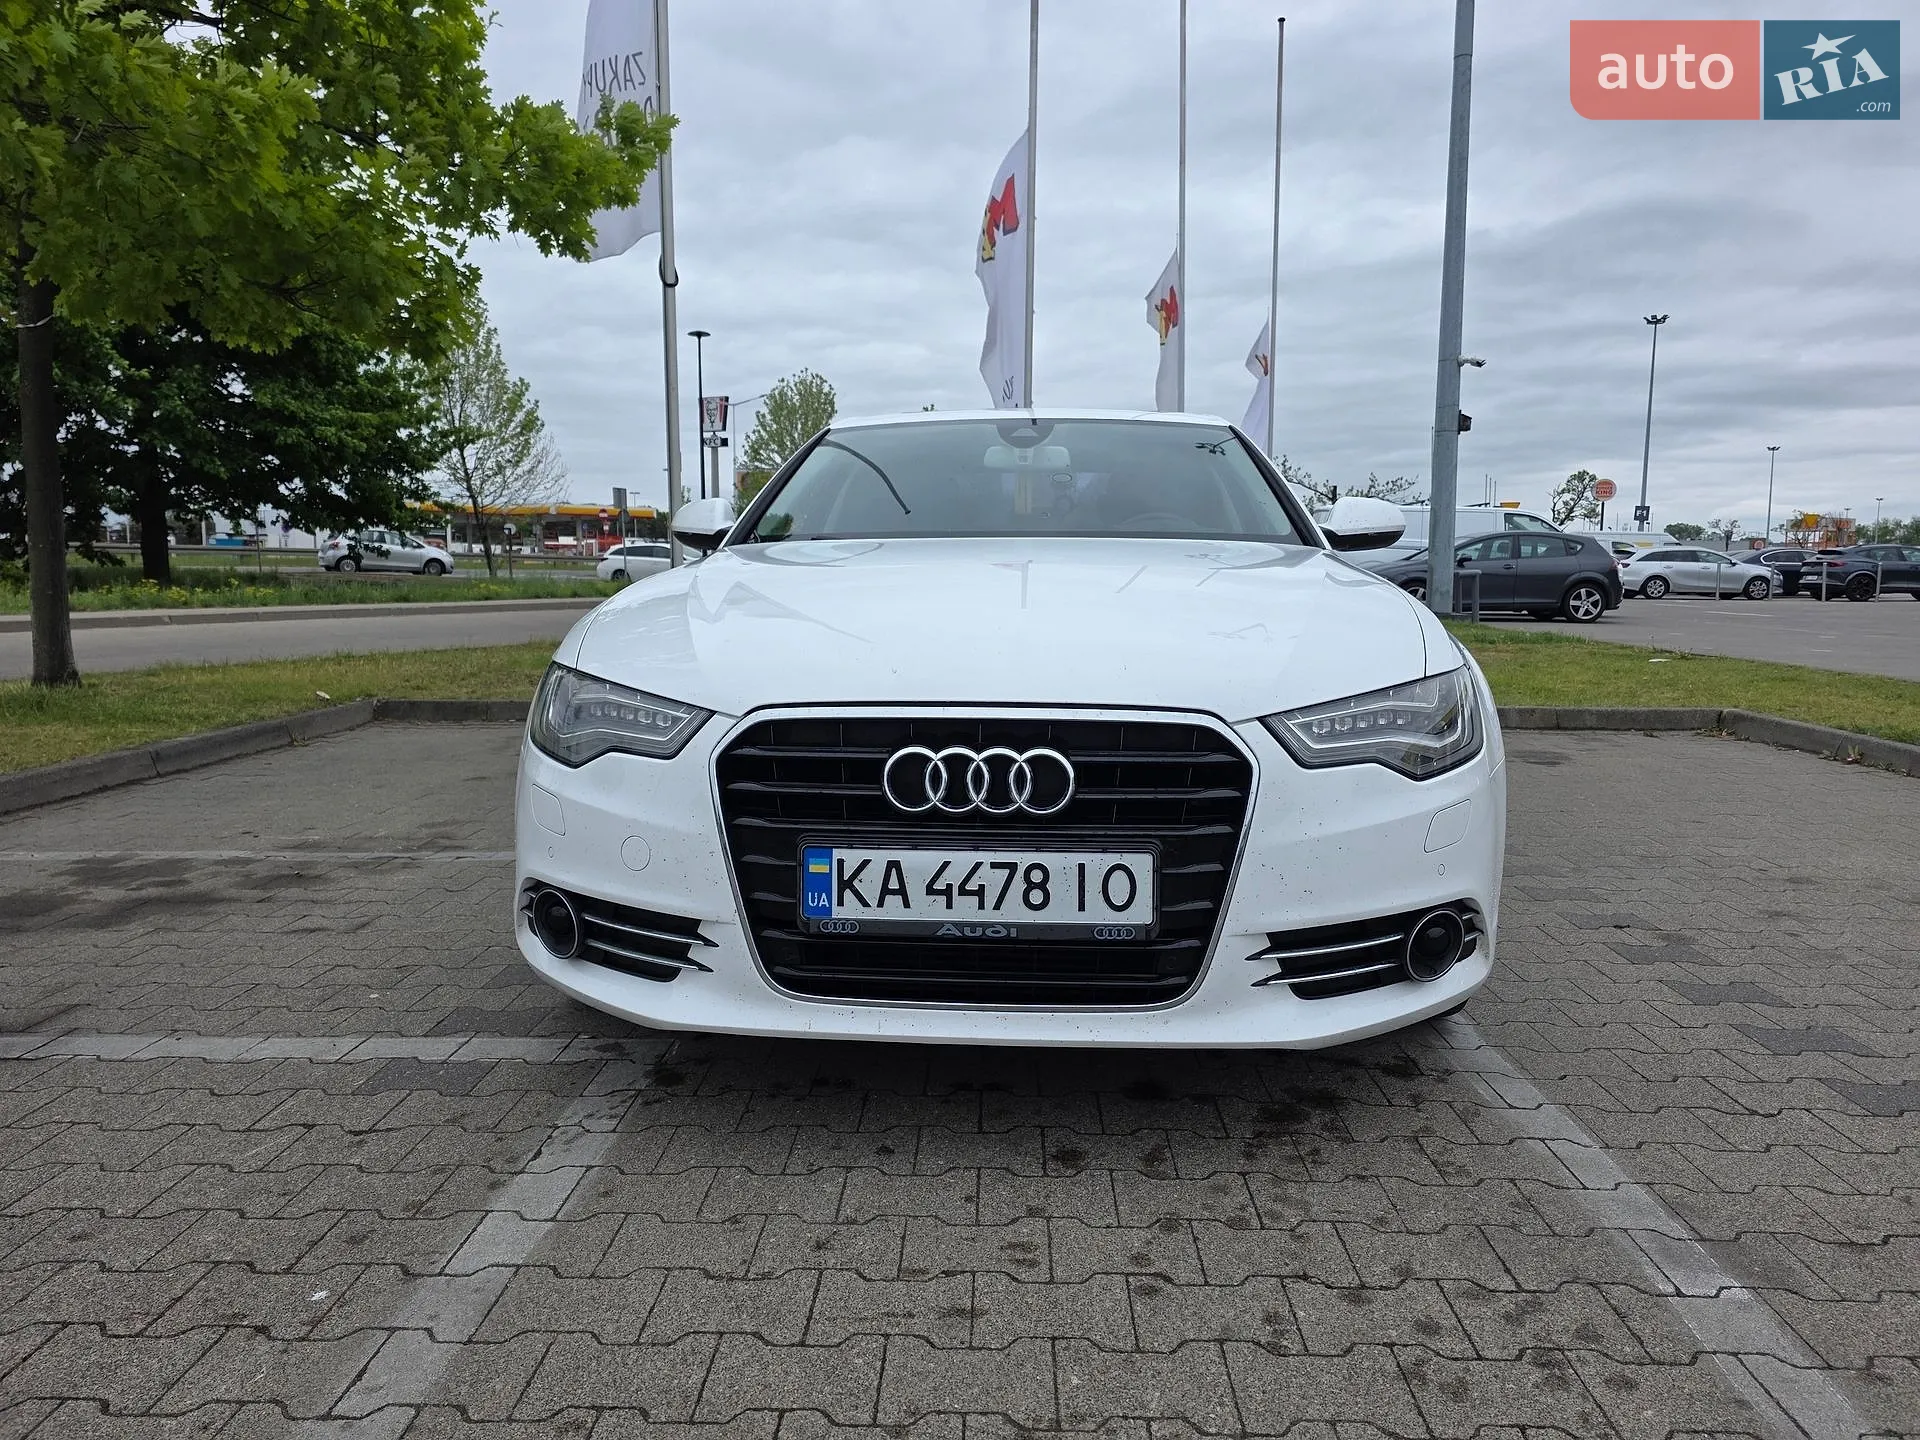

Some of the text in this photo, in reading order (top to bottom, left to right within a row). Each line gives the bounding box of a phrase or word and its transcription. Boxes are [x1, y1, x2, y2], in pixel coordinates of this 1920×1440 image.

[808, 892, 829, 907] UA
[835, 857, 911, 909] KA
[925, 860, 1051, 912] 4478
